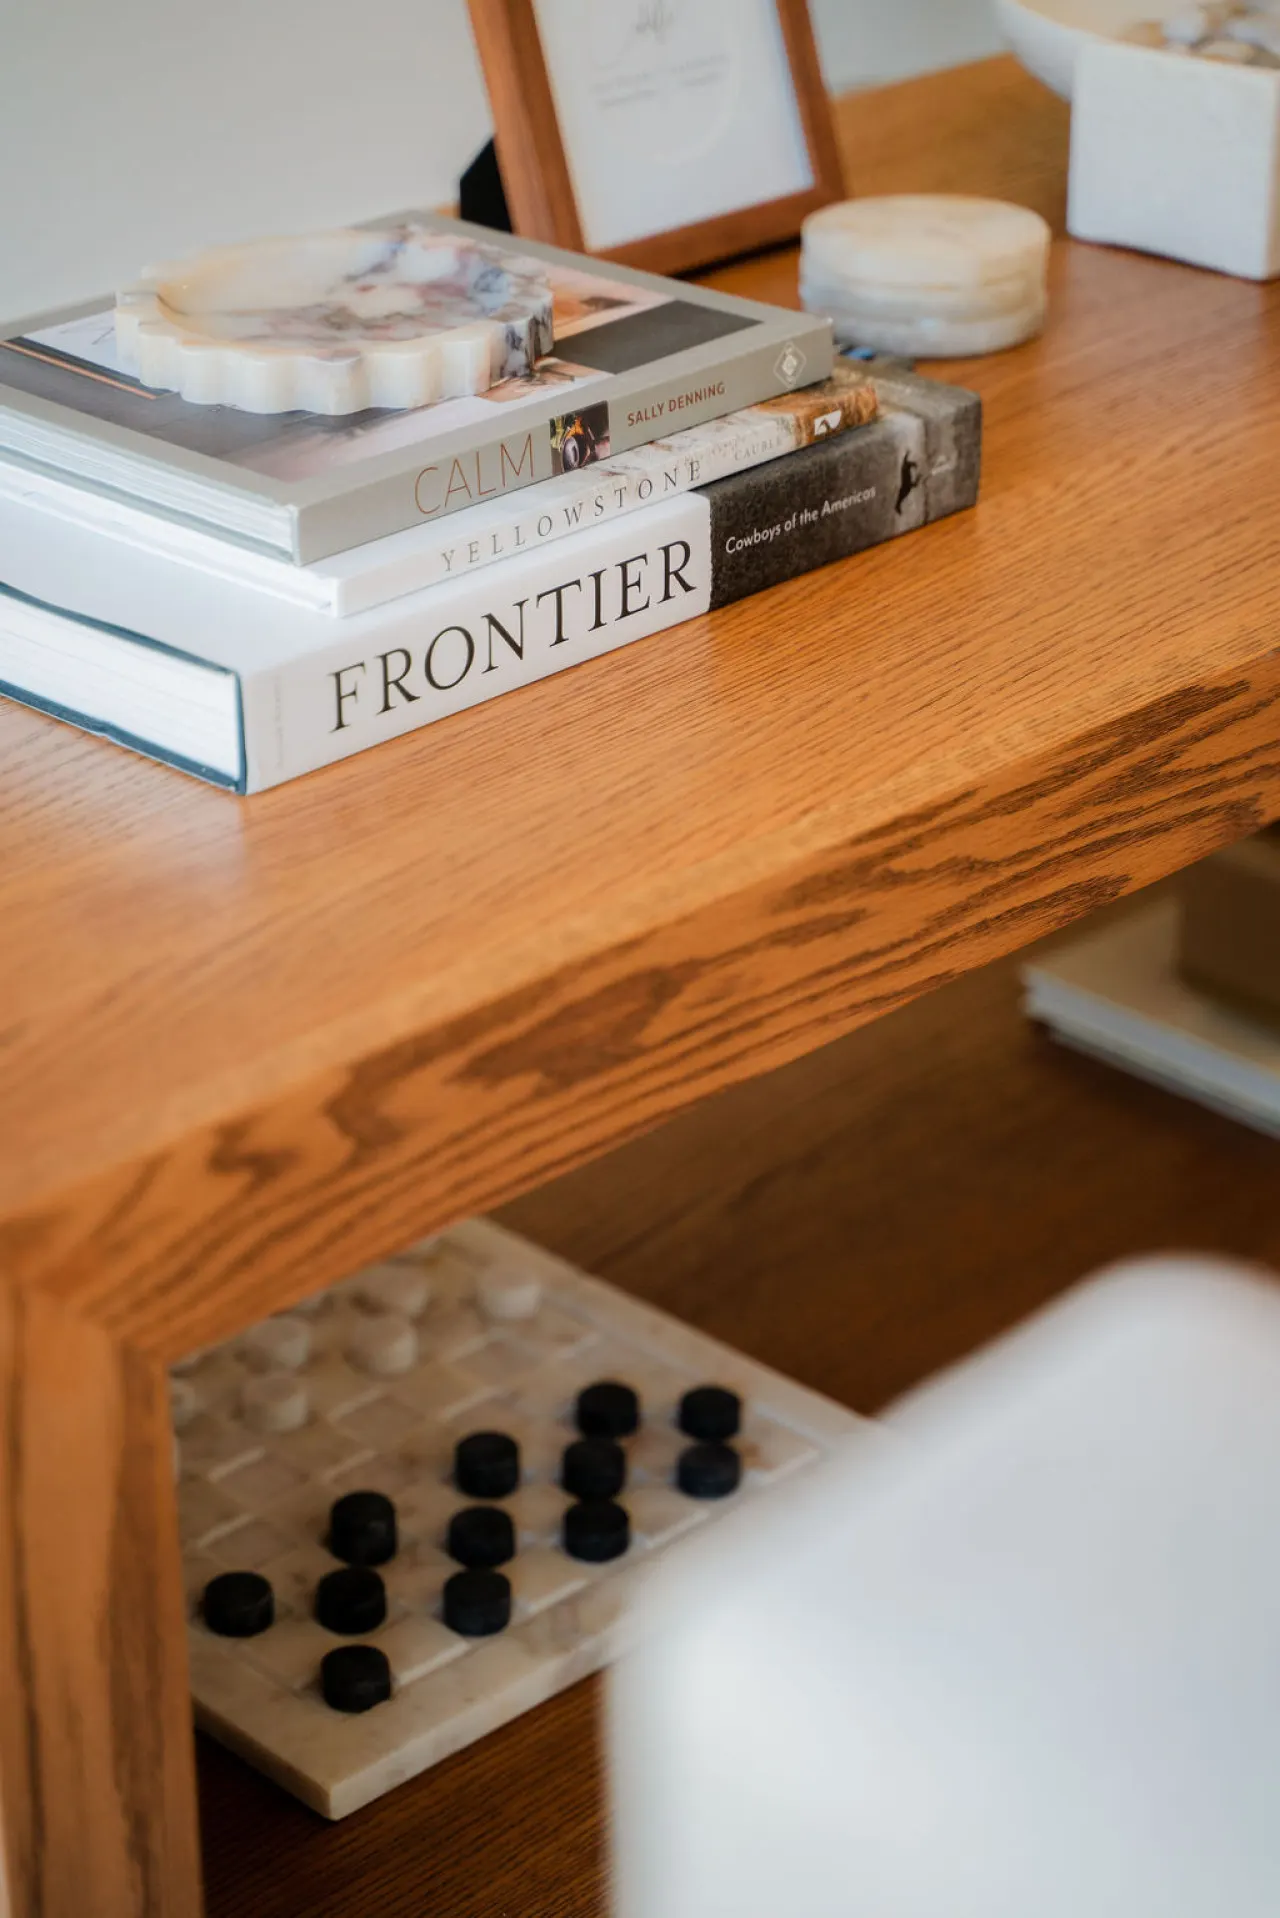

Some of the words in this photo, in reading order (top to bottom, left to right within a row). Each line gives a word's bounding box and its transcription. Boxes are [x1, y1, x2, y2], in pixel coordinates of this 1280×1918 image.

[627, 402, 665, 427] SALLY
[668, 381, 726, 413] DENNING
[413, 433, 535, 516] CALM
[441, 458, 702, 573] YELLOWSTONE
[725, 522, 782, 554] Cowboys
[784, 512, 797, 532] of
[799, 507, 819, 526] the
[821, 486, 877, 517] Americas
[328, 539, 697, 734] FRONTIER
